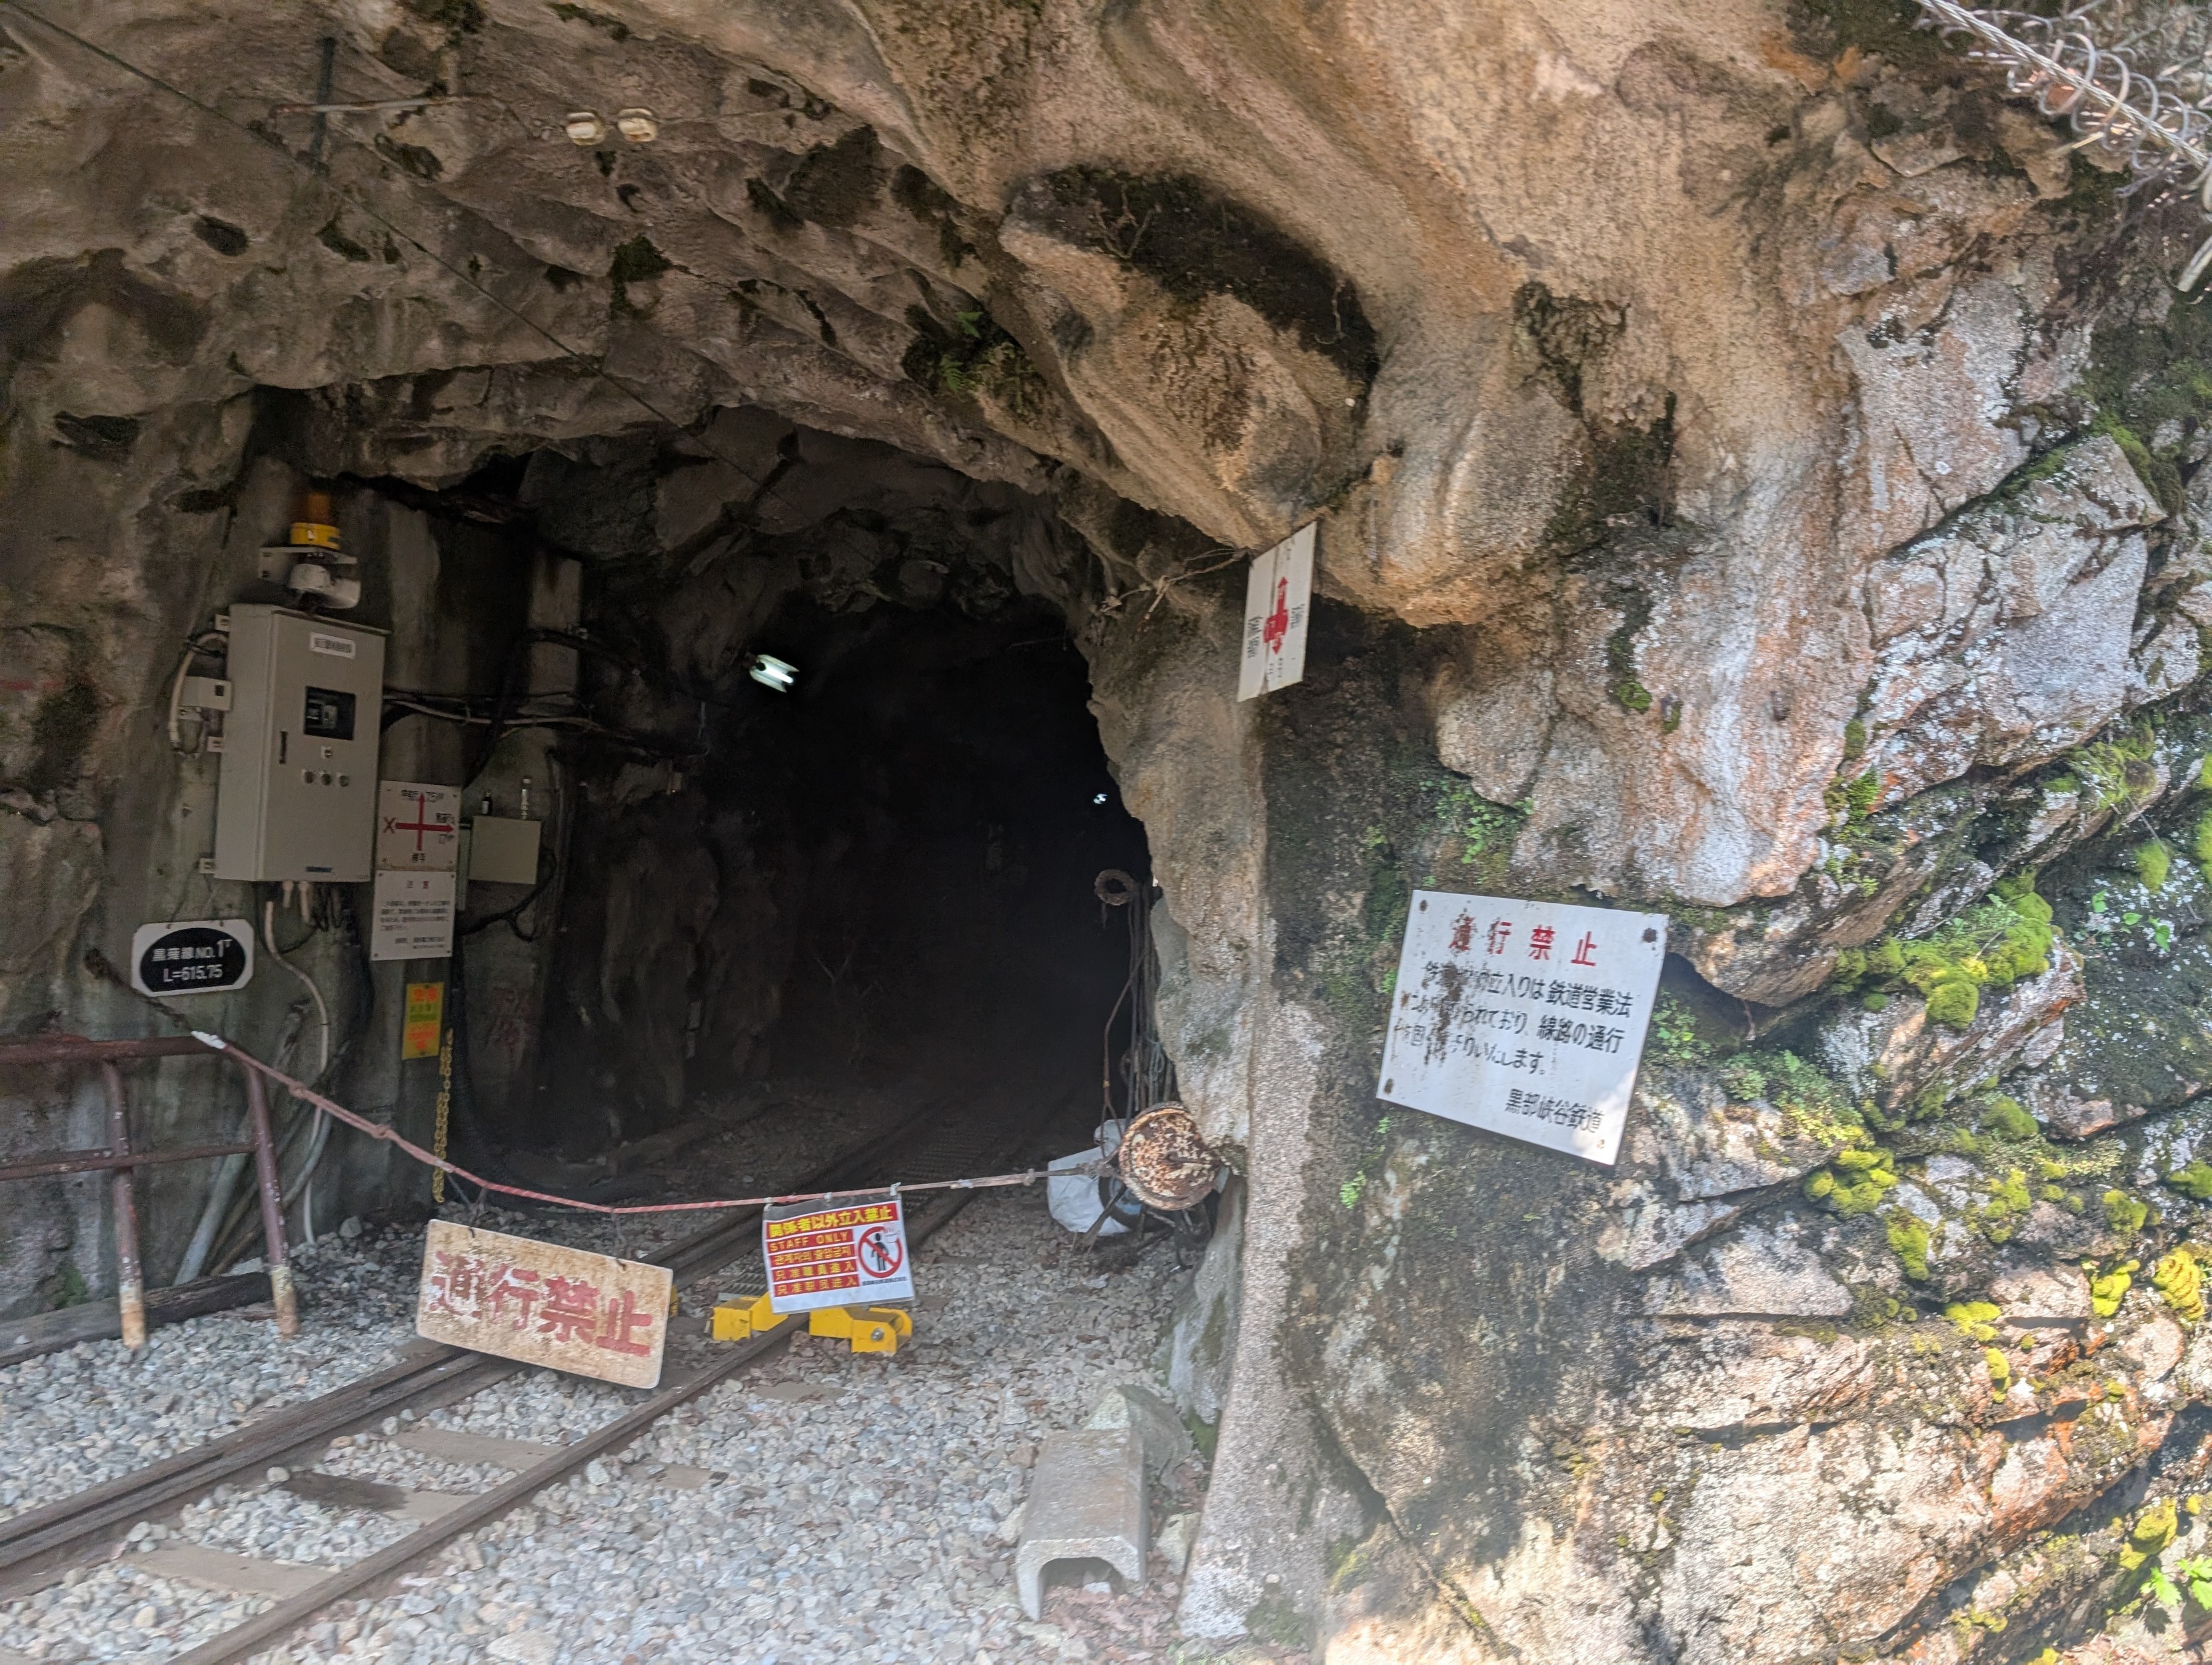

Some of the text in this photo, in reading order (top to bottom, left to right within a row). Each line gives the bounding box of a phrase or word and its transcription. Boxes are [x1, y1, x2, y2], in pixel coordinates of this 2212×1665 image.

[1449, 912, 1598, 967] 通行禁止
[1506, 1088, 1605, 1133] 黒部峡谷鉄道
[769, 1206, 893, 1238] 関係者以外立入禁止
[770, 1231, 848, 1251] STAFF ONLY
[430, 1250, 652, 1357] 通行禁止
